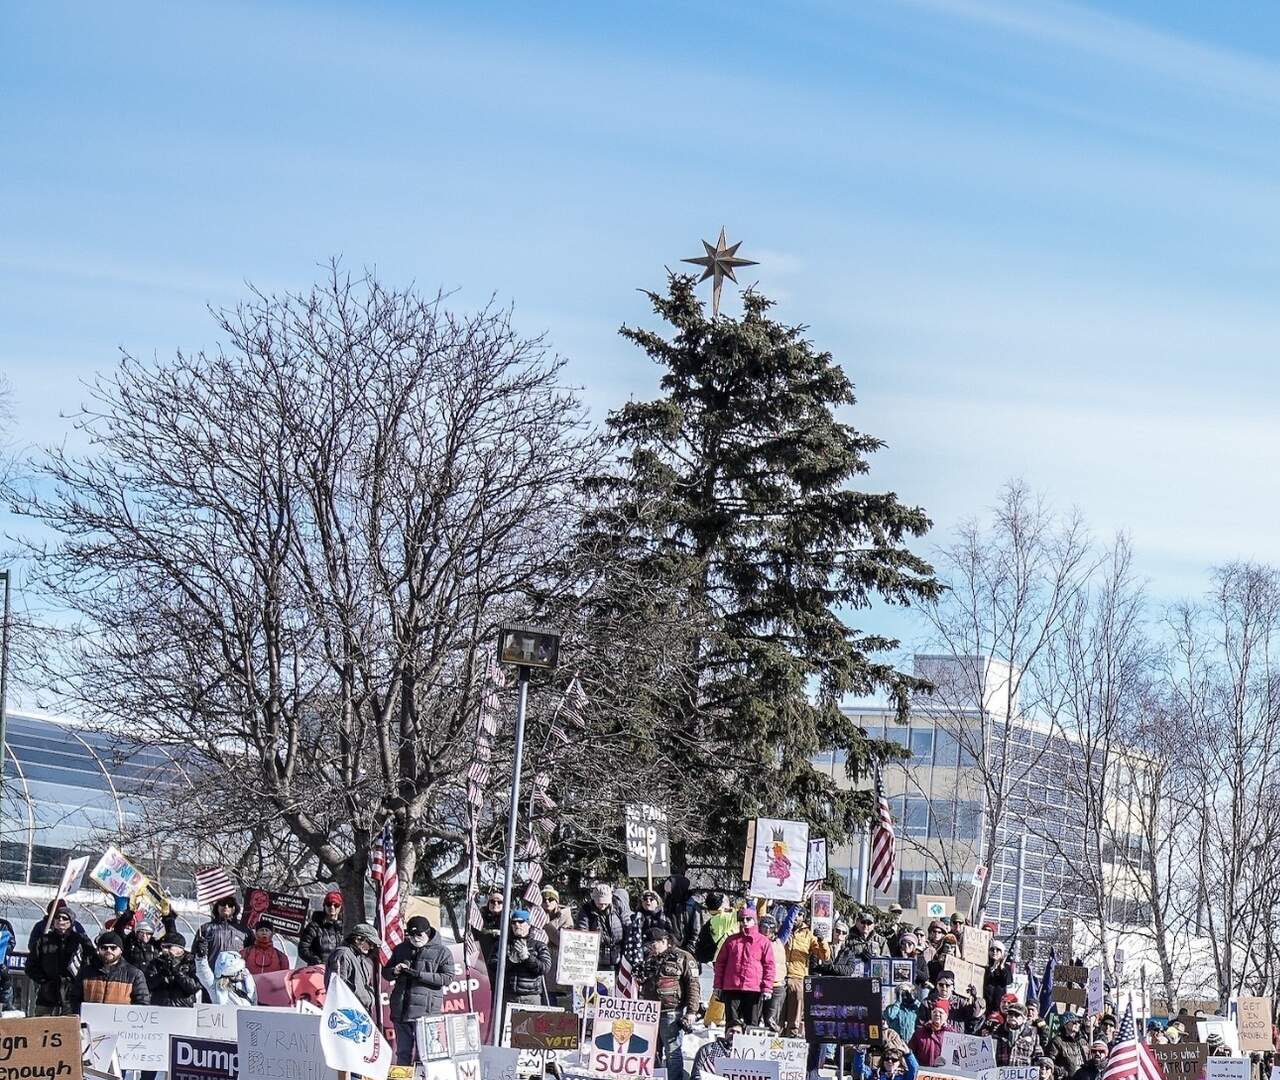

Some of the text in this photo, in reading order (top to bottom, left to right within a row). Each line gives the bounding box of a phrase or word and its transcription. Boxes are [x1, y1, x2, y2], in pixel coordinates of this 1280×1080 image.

[626, 821, 656, 844] King
[628, 840, 656, 864] Way
[599, 998, 658, 1014] POLITICAL
[113, 1008, 159, 1024] LOVE
[598, 1009, 657, 1023] PROSTITUTES
[42, 1031, 62, 1048] is
[545, 1036, 577, 1047] VOTE
[177, 1042, 239, 1075] Dump
[595, 1053, 651, 1075] SUCK
[1000, 1069, 1037, 1080] PUBLIC
